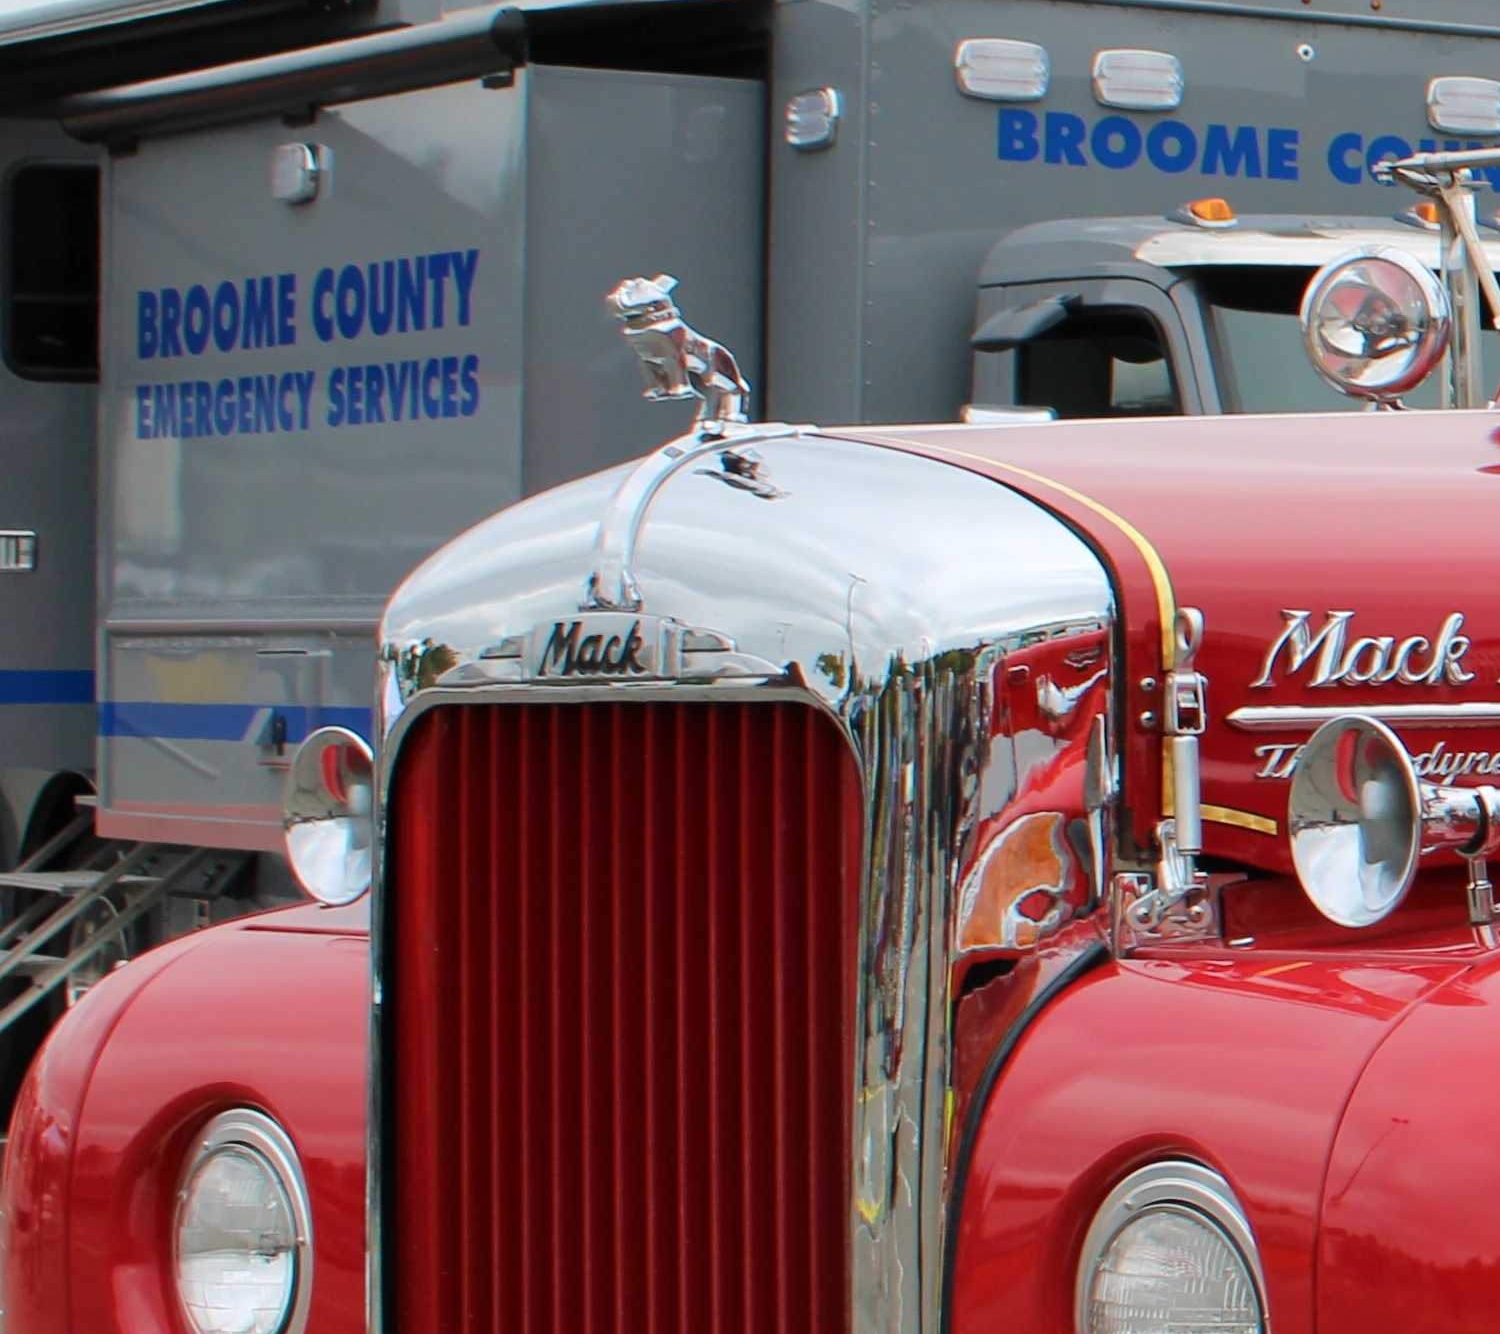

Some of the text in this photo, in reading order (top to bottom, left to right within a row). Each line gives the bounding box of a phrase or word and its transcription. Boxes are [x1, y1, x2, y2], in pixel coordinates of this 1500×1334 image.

[998, 107, 1299, 181] BROOME
[137, 249, 479, 360] BROOME COUNTY
[136, 354, 480, 440] EMERGENCY SERVICES
[539, 620, 645, 677] Mack
[1249, 608, 1475, 688] Mack
